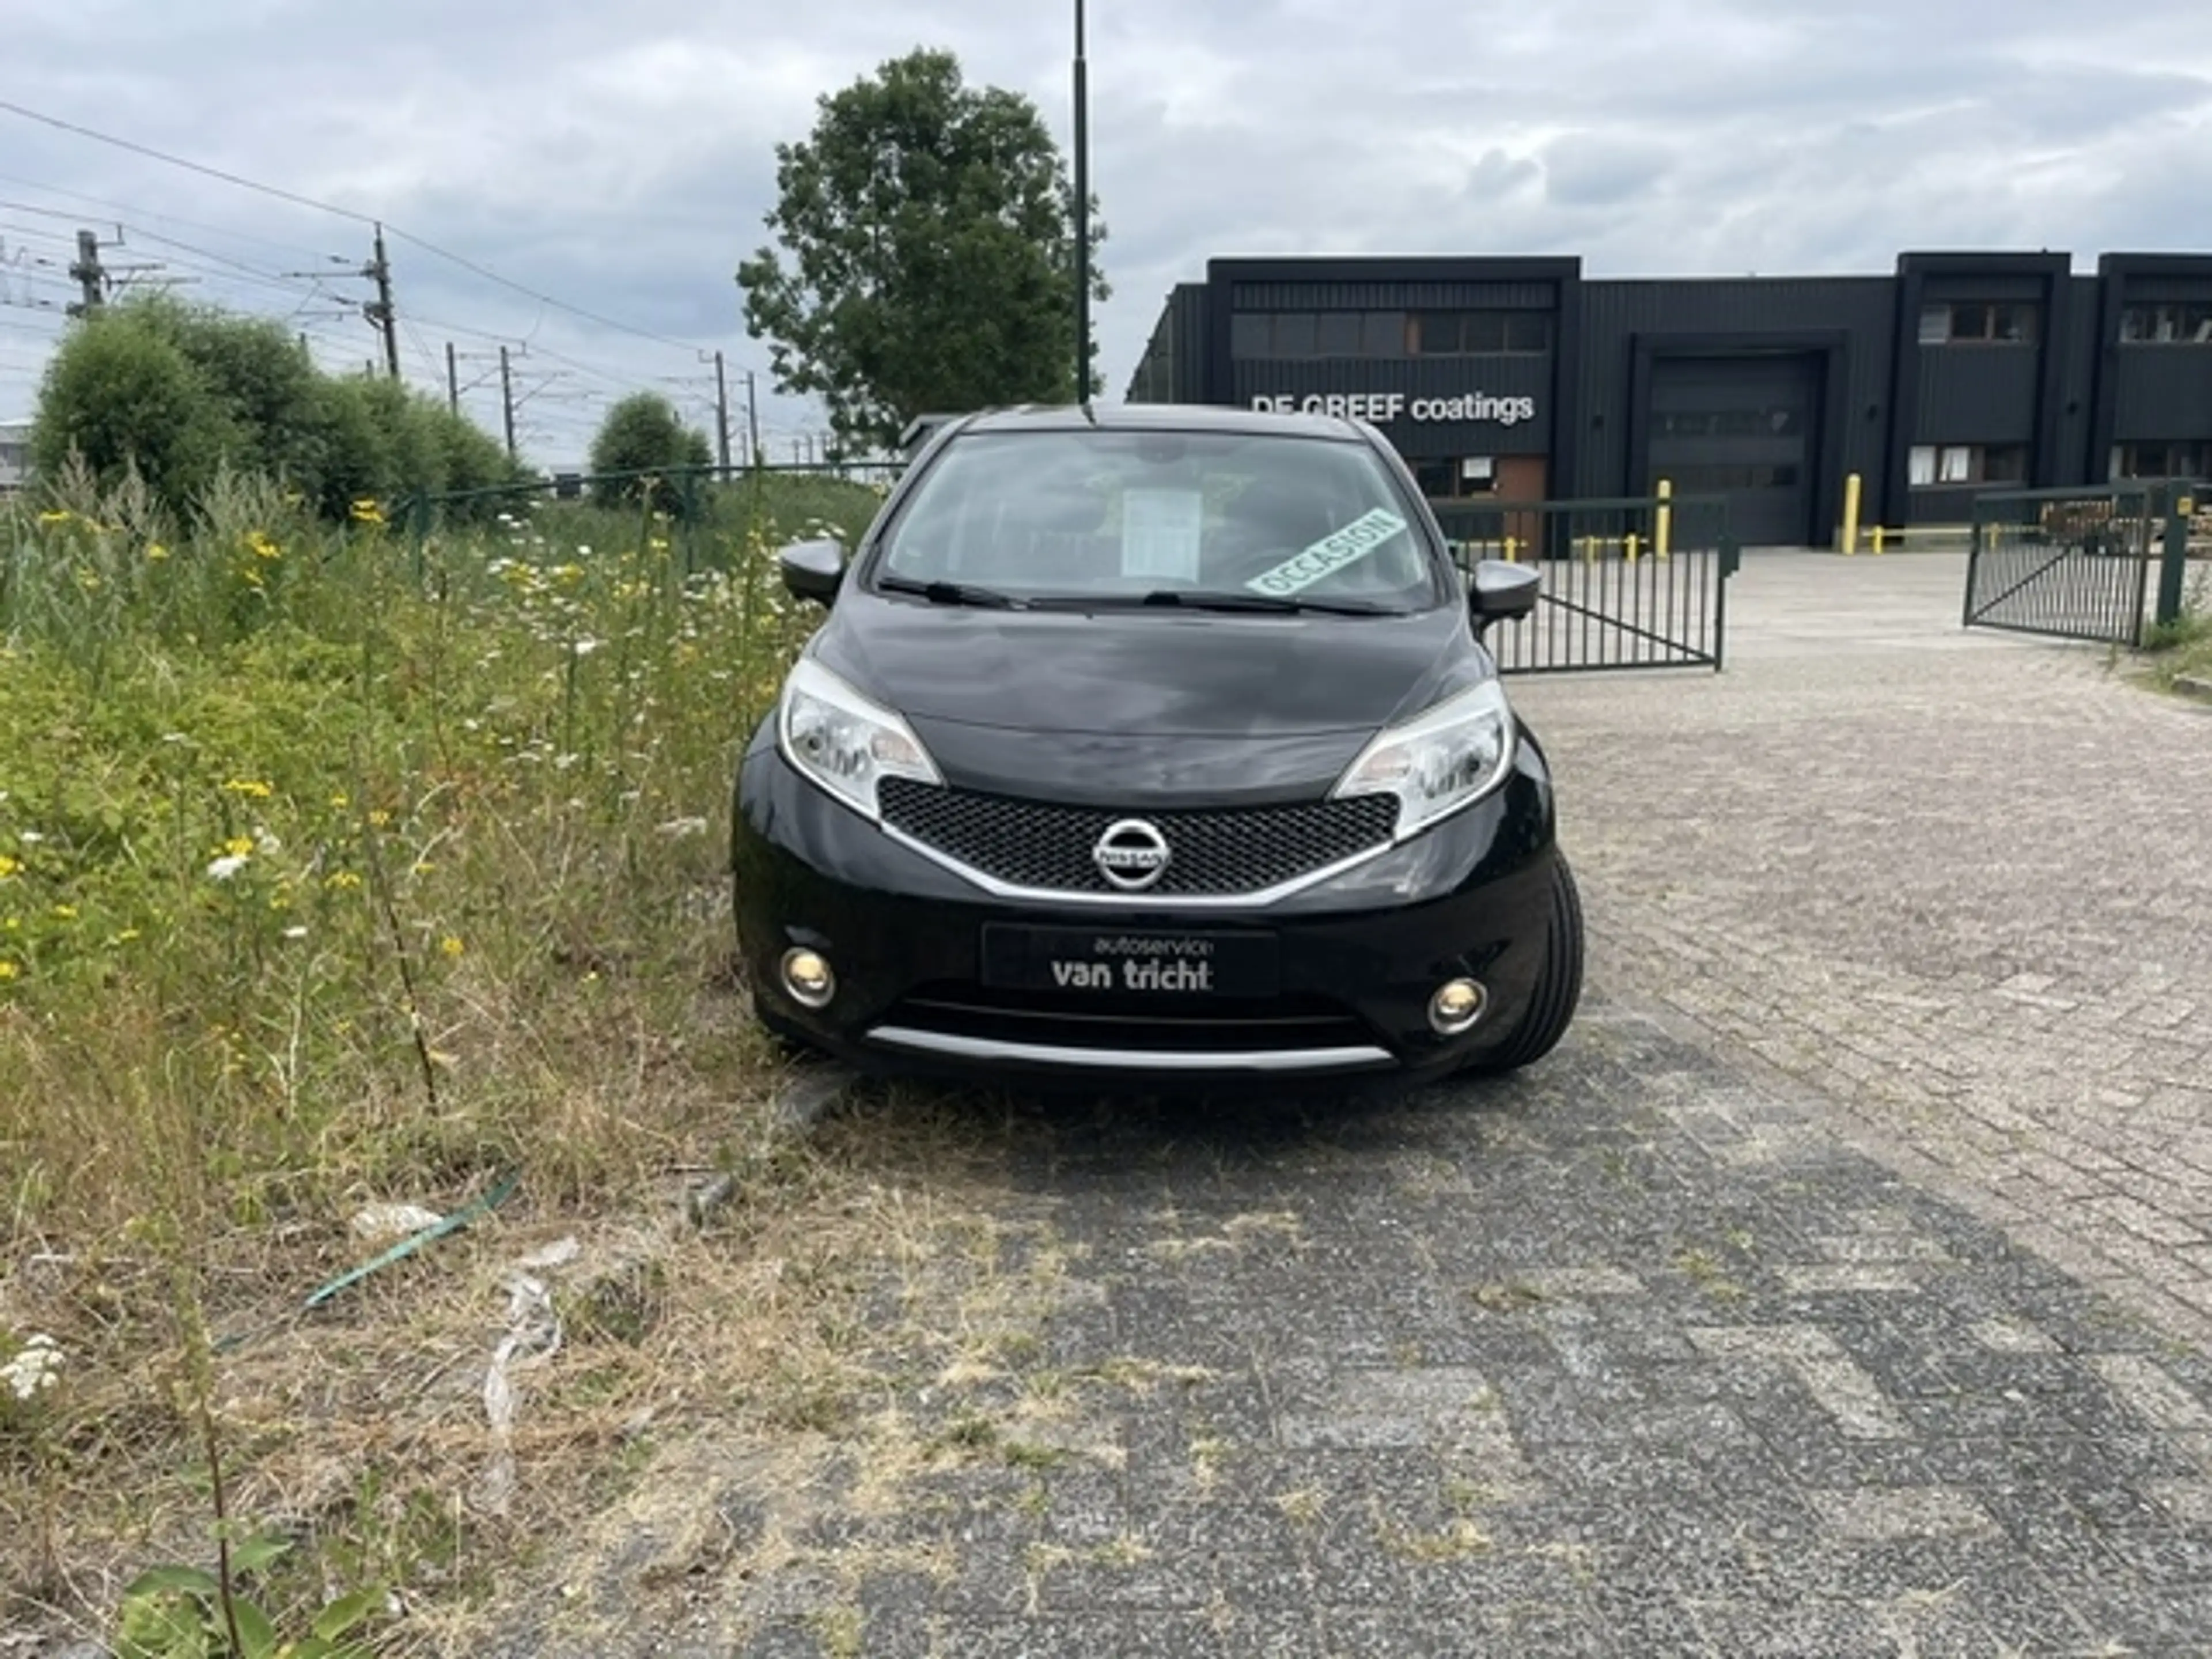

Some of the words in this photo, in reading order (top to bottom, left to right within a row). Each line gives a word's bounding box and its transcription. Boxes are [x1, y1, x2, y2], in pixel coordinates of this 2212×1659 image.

[1252, 394, 1294, 415] DE
[1302, 393, 1404, 421] GREEF
[1410, 391, 1535, 425] coatings
[1261, 514, 1396, 591] OCCASION
[1099, 850, 1164, 865] NISSAN
[1051, 960, 1111, 988] van
[1122, 958, 1213, 990] tricht
